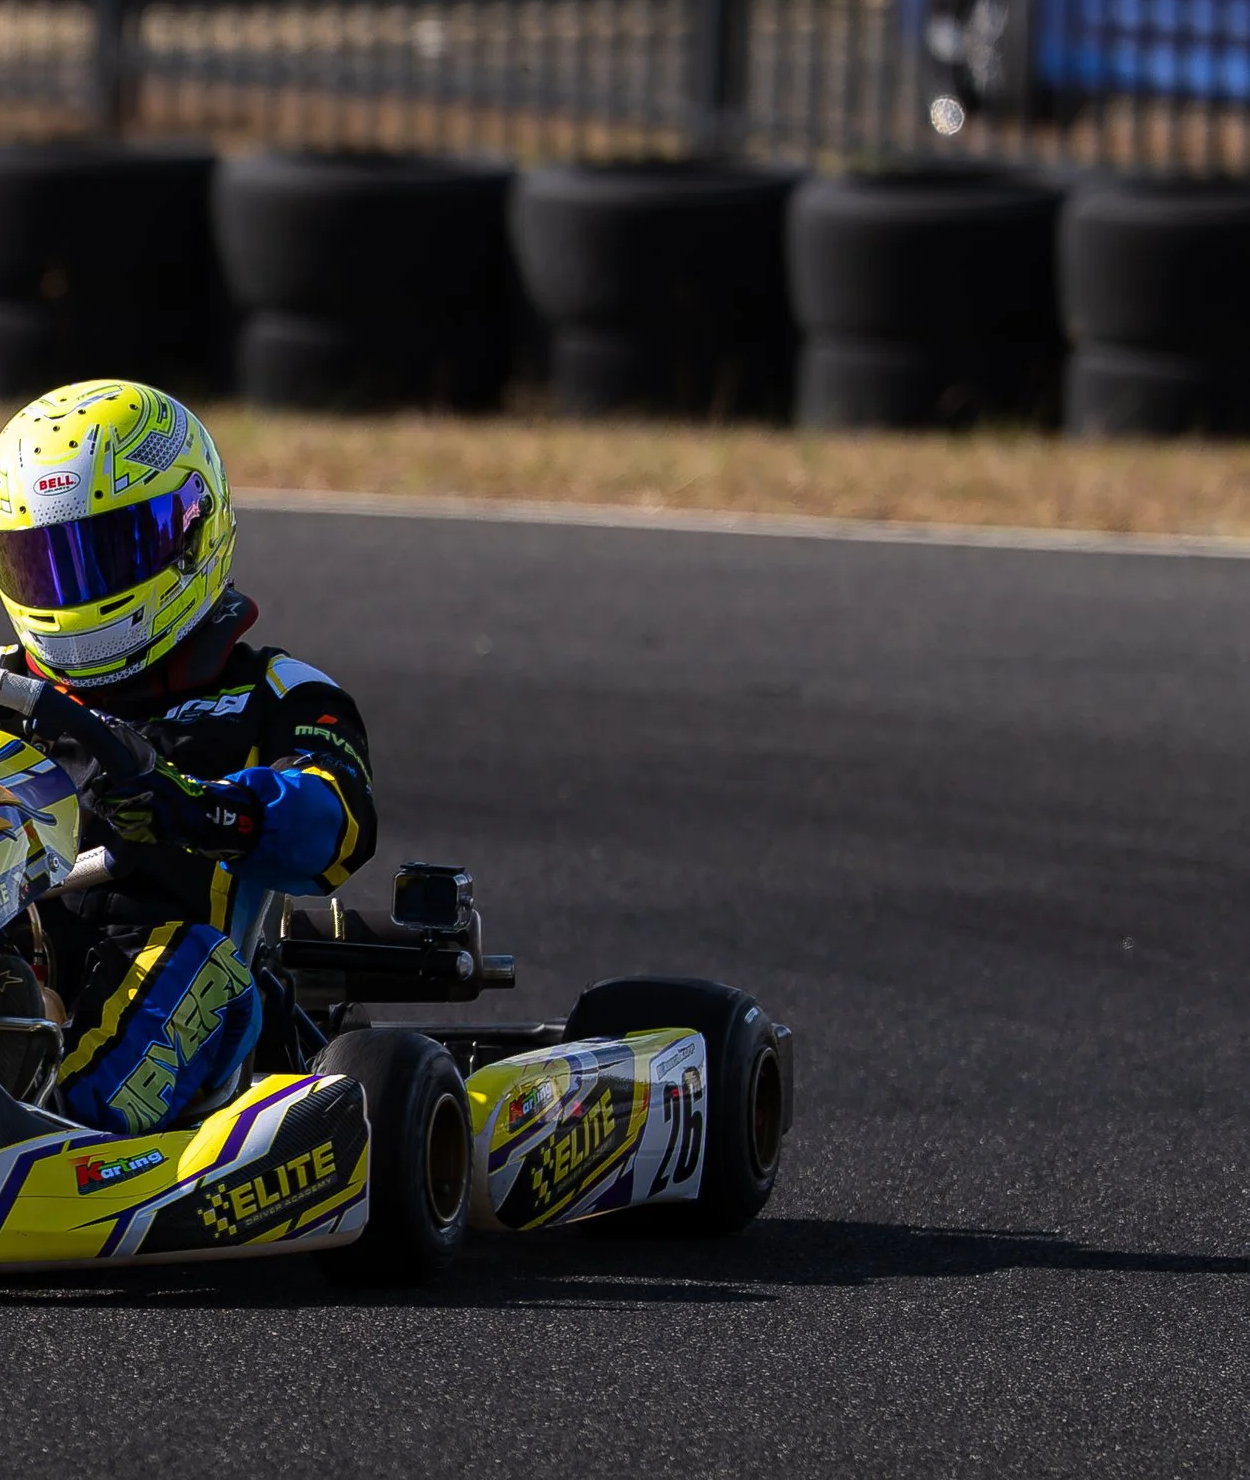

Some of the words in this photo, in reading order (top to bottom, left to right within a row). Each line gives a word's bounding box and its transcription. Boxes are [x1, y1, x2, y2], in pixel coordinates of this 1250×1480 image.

[39, 475, 74, 491] BELL
[554, 1088, 616, 1185] ELITE
[648, 1066, 704, 1199] 26
[76, 1151, 163, 1183] Karting
[229, 1141, 337, 1220] ELITE
[245, 1203, 282, 1226] DRIVER
[285, 1177, 333, 1206] ACADEMY
